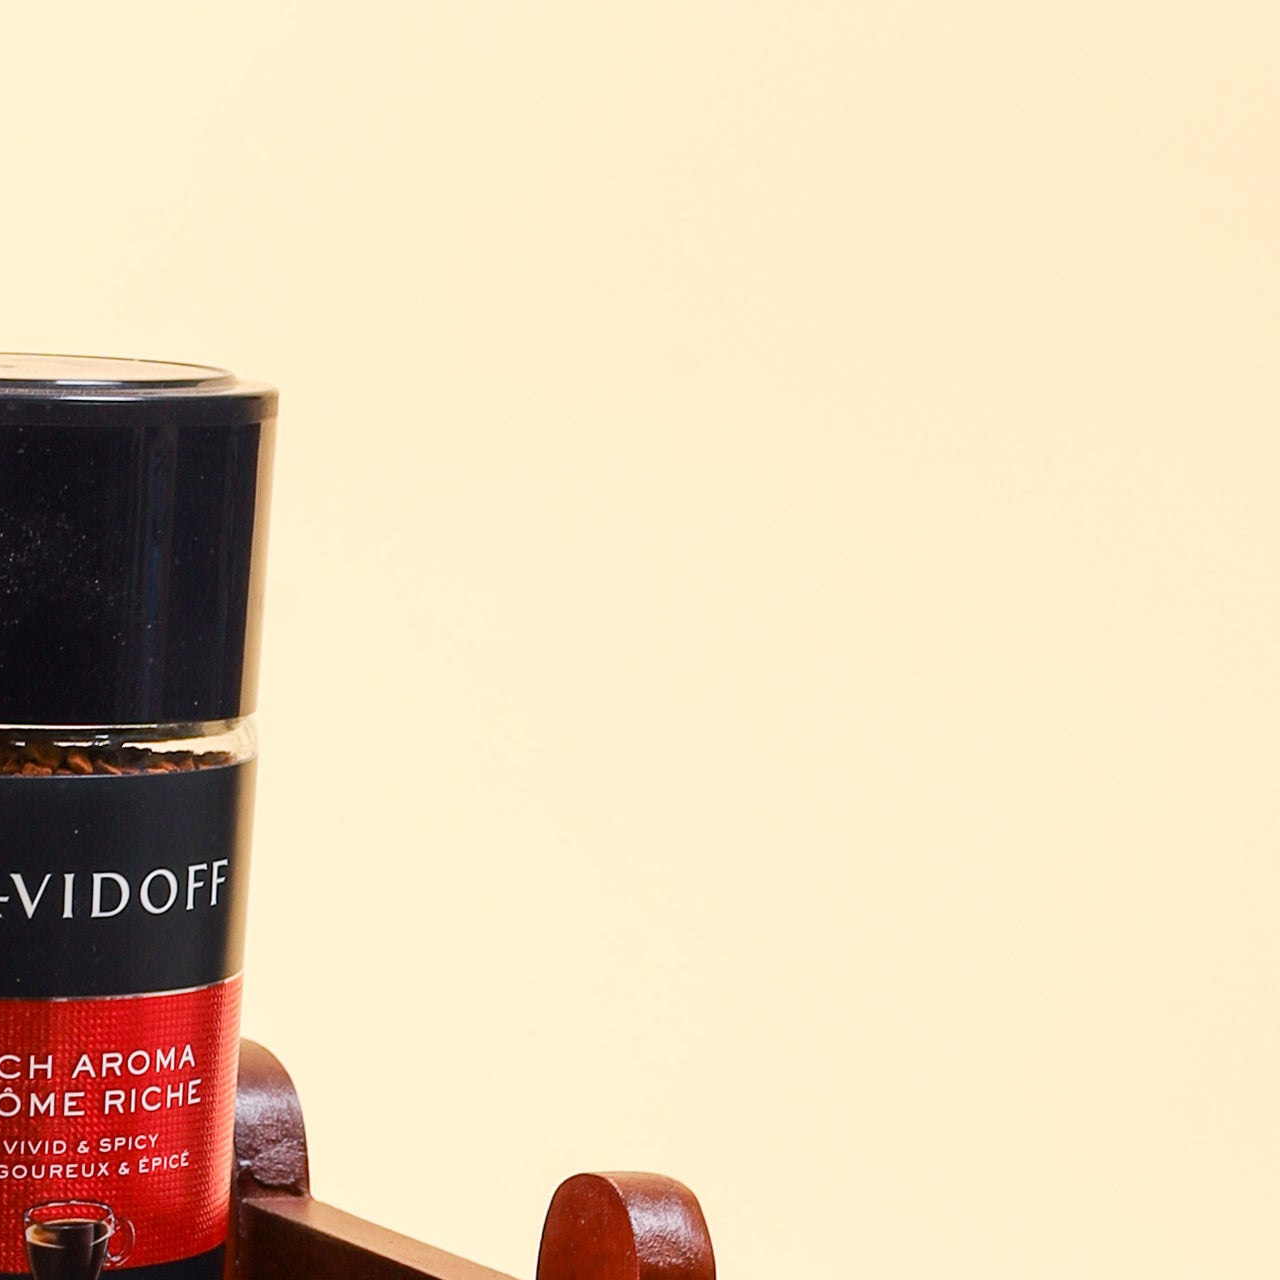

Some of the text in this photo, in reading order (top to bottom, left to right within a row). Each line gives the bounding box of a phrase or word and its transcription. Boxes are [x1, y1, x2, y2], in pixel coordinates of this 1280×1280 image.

[71, 1044, 196, 1079] AROMA
[104, 1078, 202, 1115] RICHE
[3, 1133, 159, 1155] VIVID & SPICY
[118, 1161, 130, 1175] &
[138, 1149, 190, 1174] ÉPICÉ
